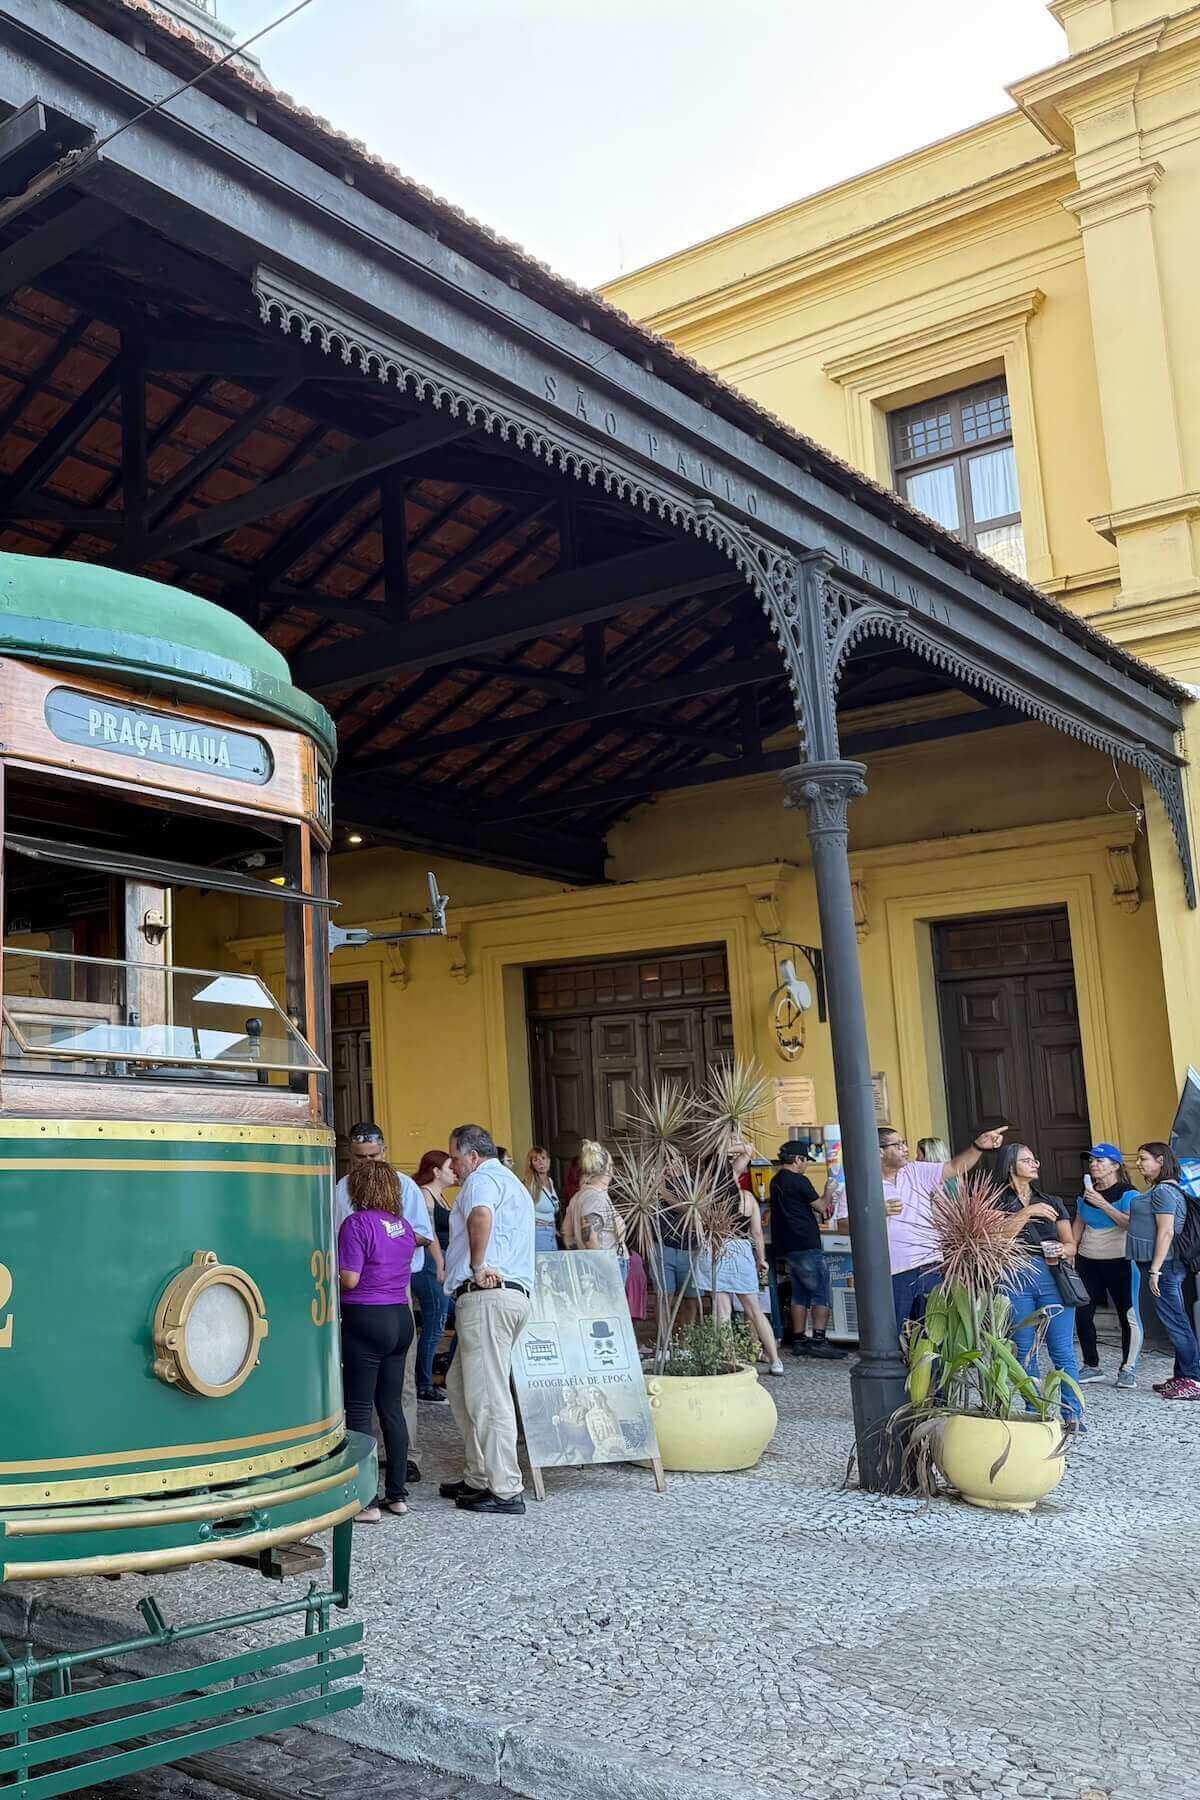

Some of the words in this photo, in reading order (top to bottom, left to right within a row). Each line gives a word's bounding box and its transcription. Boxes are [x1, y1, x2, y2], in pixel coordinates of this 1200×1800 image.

[544, 375, 617, 435] SÃO
[648, 433, 758, 515] PAULO
[840, 545, 953, 626] RAILWAY
[88, 708, 163, 756] PRAÇA
[169, 728, 231, 769] MAUÁ
[586, 1375, 600, 1385] DE
